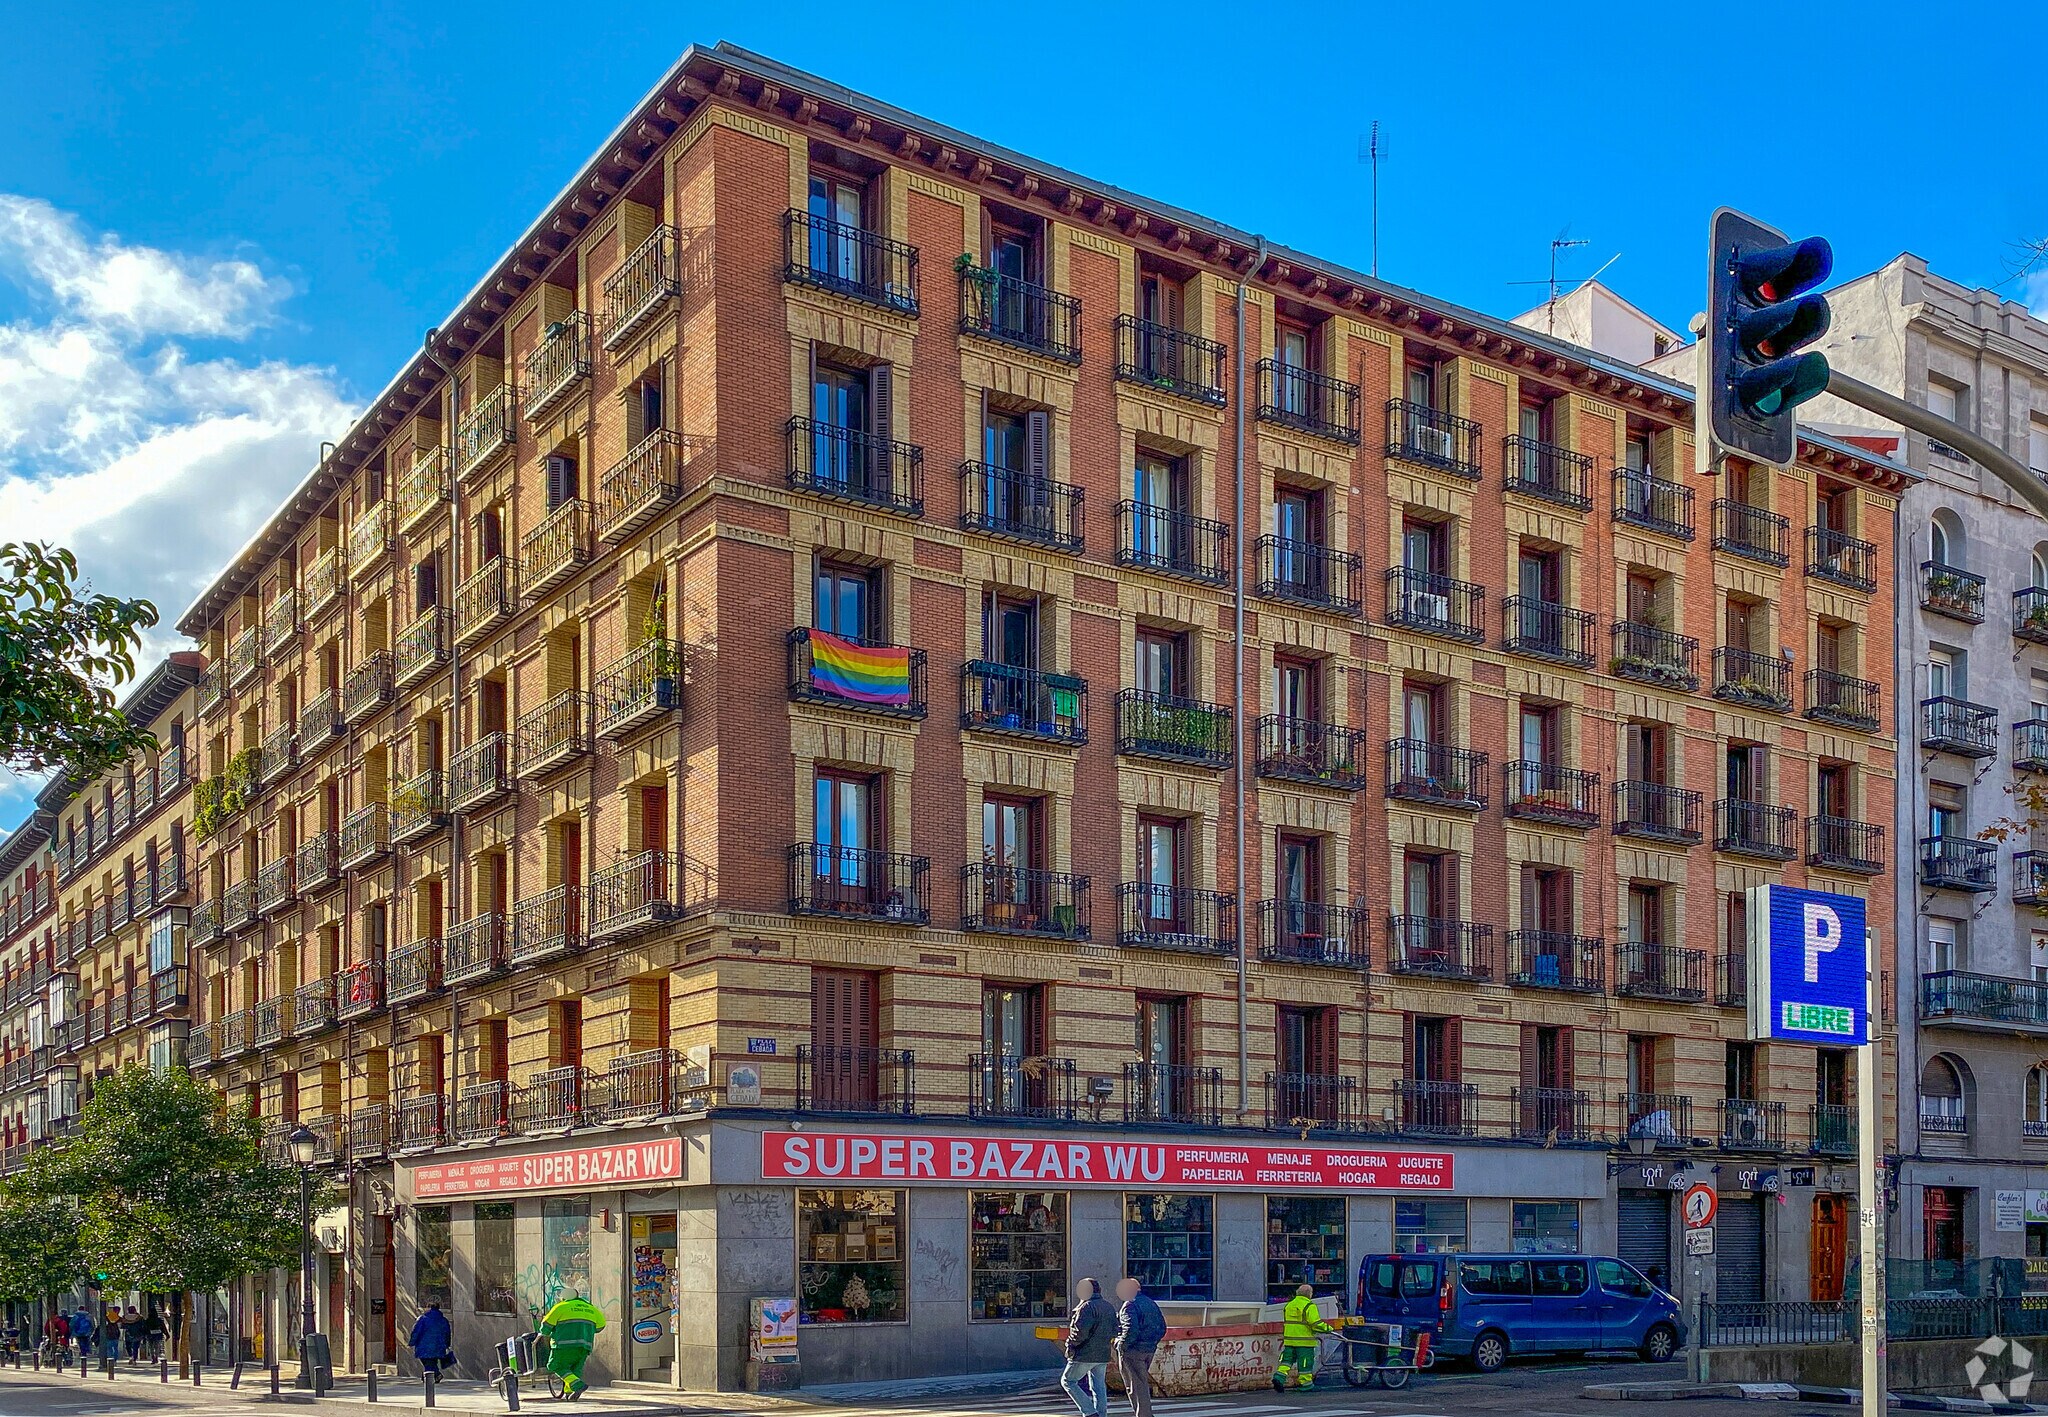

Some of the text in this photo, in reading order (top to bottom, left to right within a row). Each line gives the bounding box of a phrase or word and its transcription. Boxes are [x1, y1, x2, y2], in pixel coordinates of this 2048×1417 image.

[1804, 903, 1842, 983] P
[1787, 1004, 1850, 1032] LIBRE
[751, 1045, 773, 1053] CEBADA
[523, 1143, 673, 1186] SUPER BAZAR WU
[783, 1136, 1165, 1182] SUPER BAZAR WU
[1176, 1150, 1443, 1169] PERFUMERIA MENAJE DROGUERIA JUGUETE
[418, 1162, 519, 1180] PERFUMERIA MENAJE DROGUERIA JUGUETE
[1182, 1168, 1440, 1185] PAPELERIA FERRETERIA HOGAR REGALO
[420, 1176, 518, 1192] PAPELERIA FERRETERIA HOGAR REGALO
